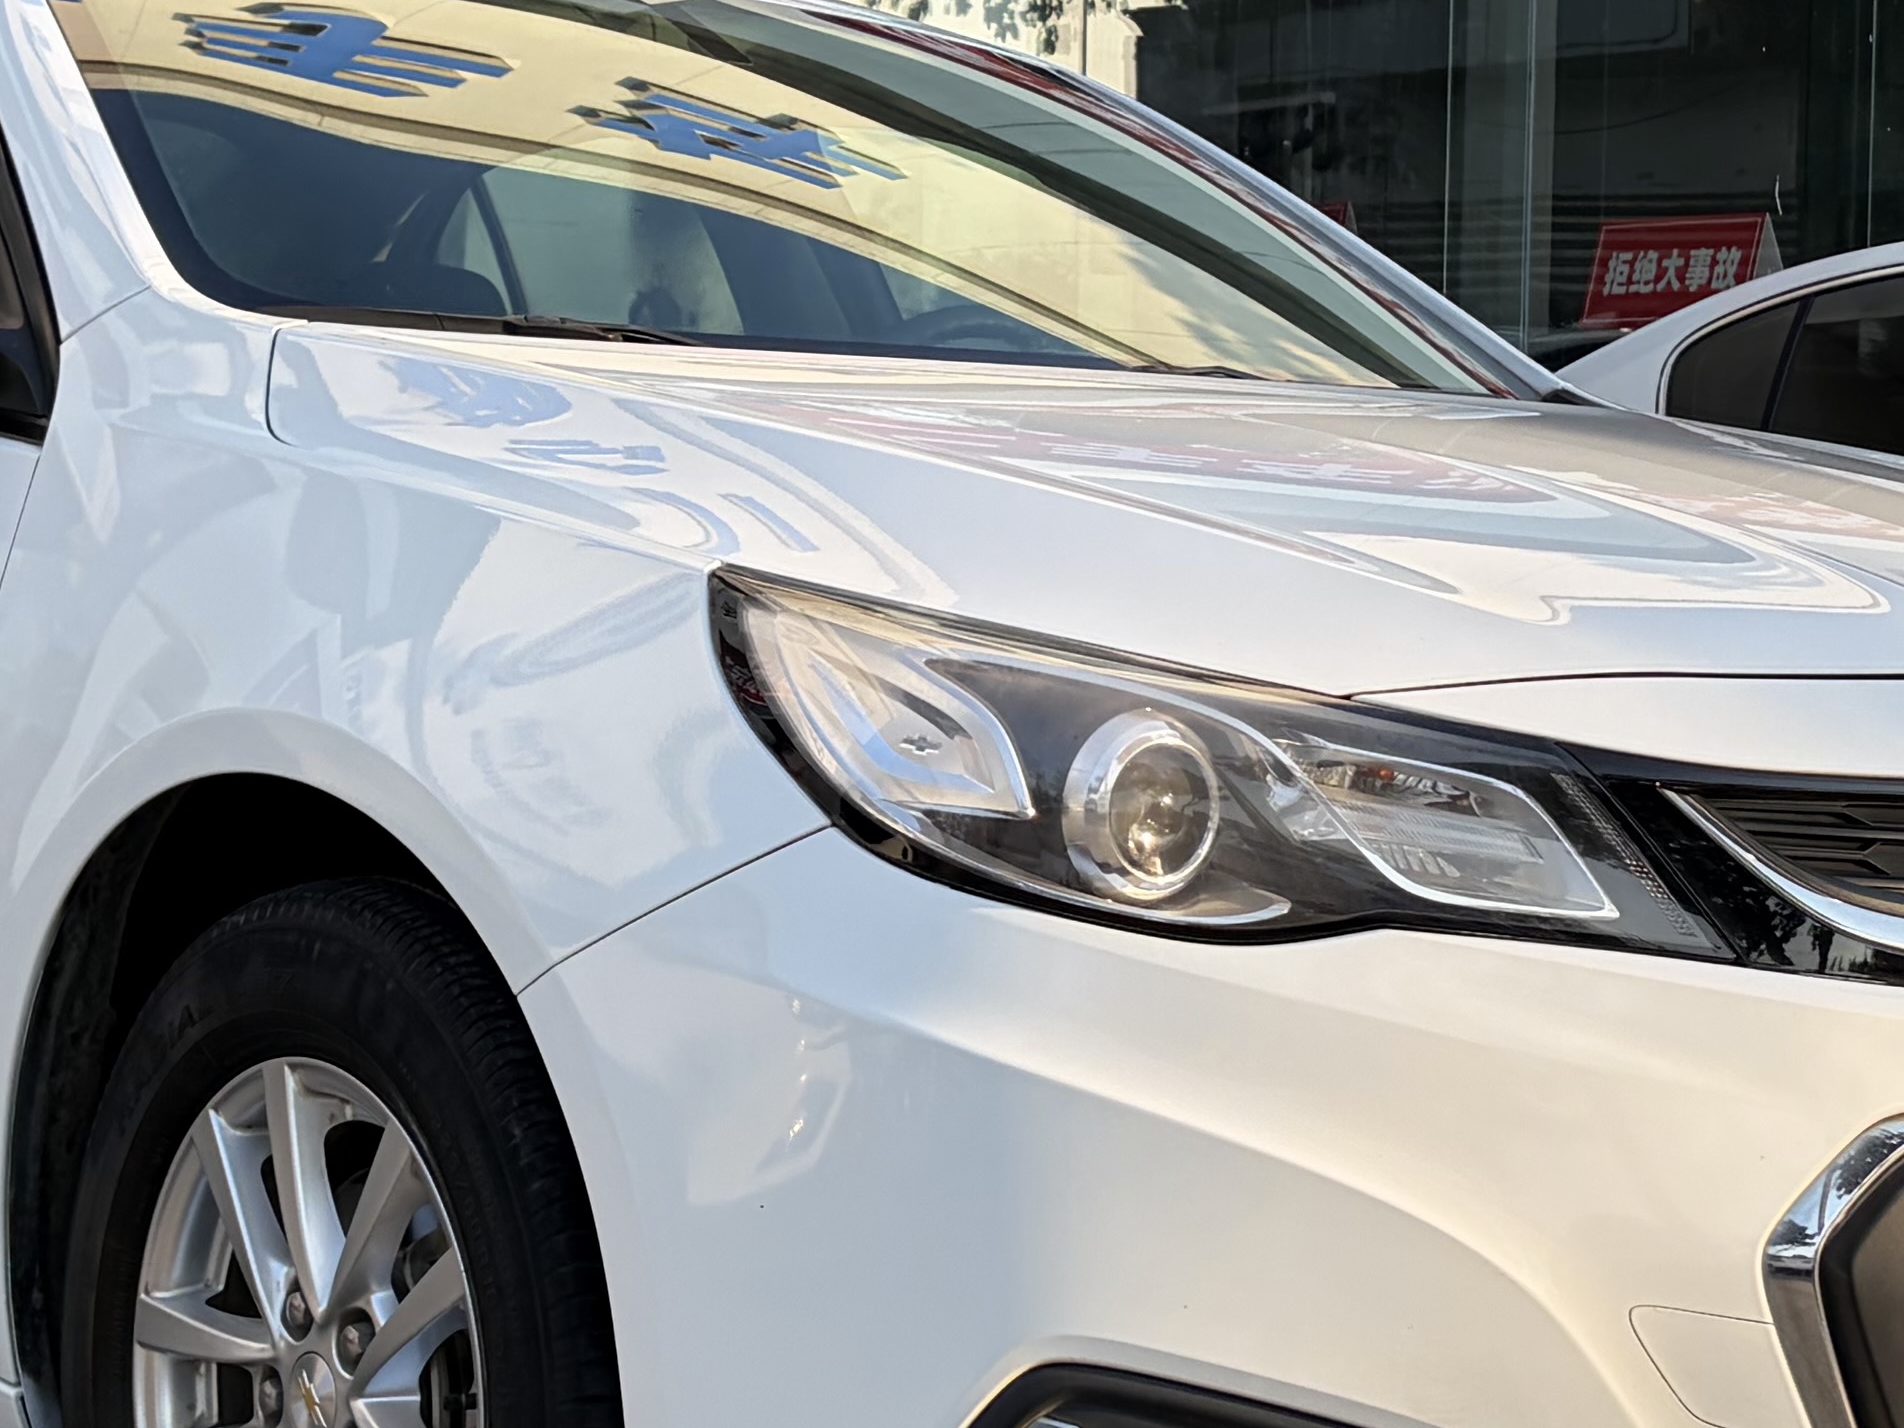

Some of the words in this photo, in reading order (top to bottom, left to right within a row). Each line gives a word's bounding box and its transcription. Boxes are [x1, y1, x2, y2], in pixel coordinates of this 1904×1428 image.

[1602, 245, 1742, 297] 拒绝大事故
